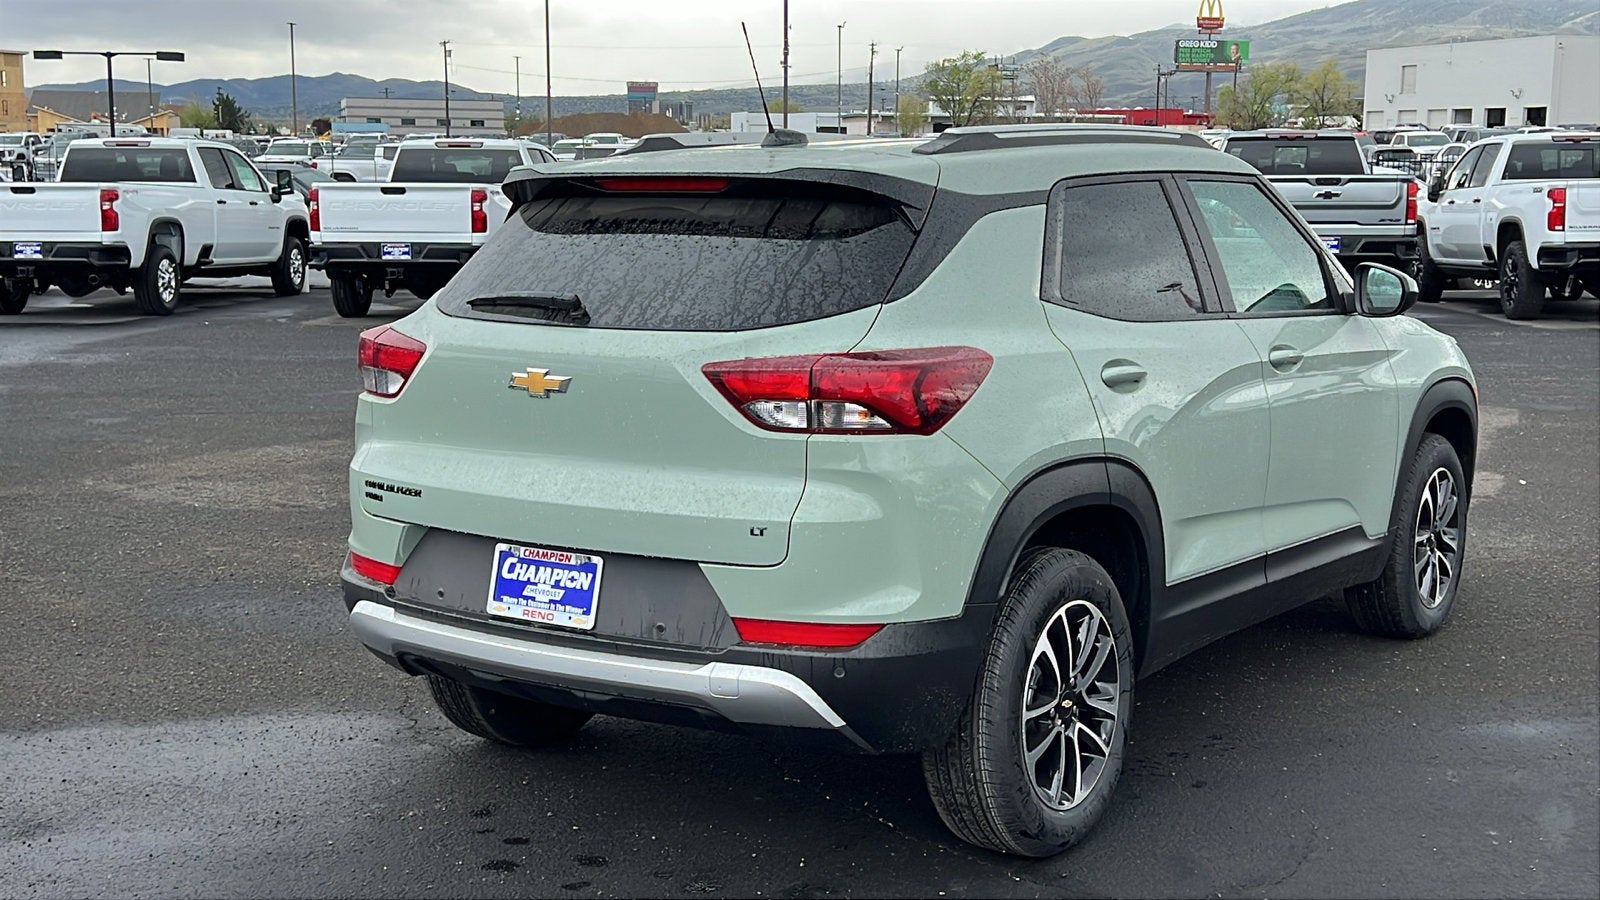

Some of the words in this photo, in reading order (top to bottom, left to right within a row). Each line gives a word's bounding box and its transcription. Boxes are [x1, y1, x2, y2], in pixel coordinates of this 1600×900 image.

[1179, 40, 1199, 48] GREG
[1200, 40, 1218, 48] KIDD
[0, 200, 89, 211] VROLET
[750, 526, 768, 537] LT
[523, 548, 573, 563] CHAMPION
[501, 557, 593, 591] CHAMPION
[526, 586, 562, 599] CHEVROLET
[522, 609, 555, 621] RENO
